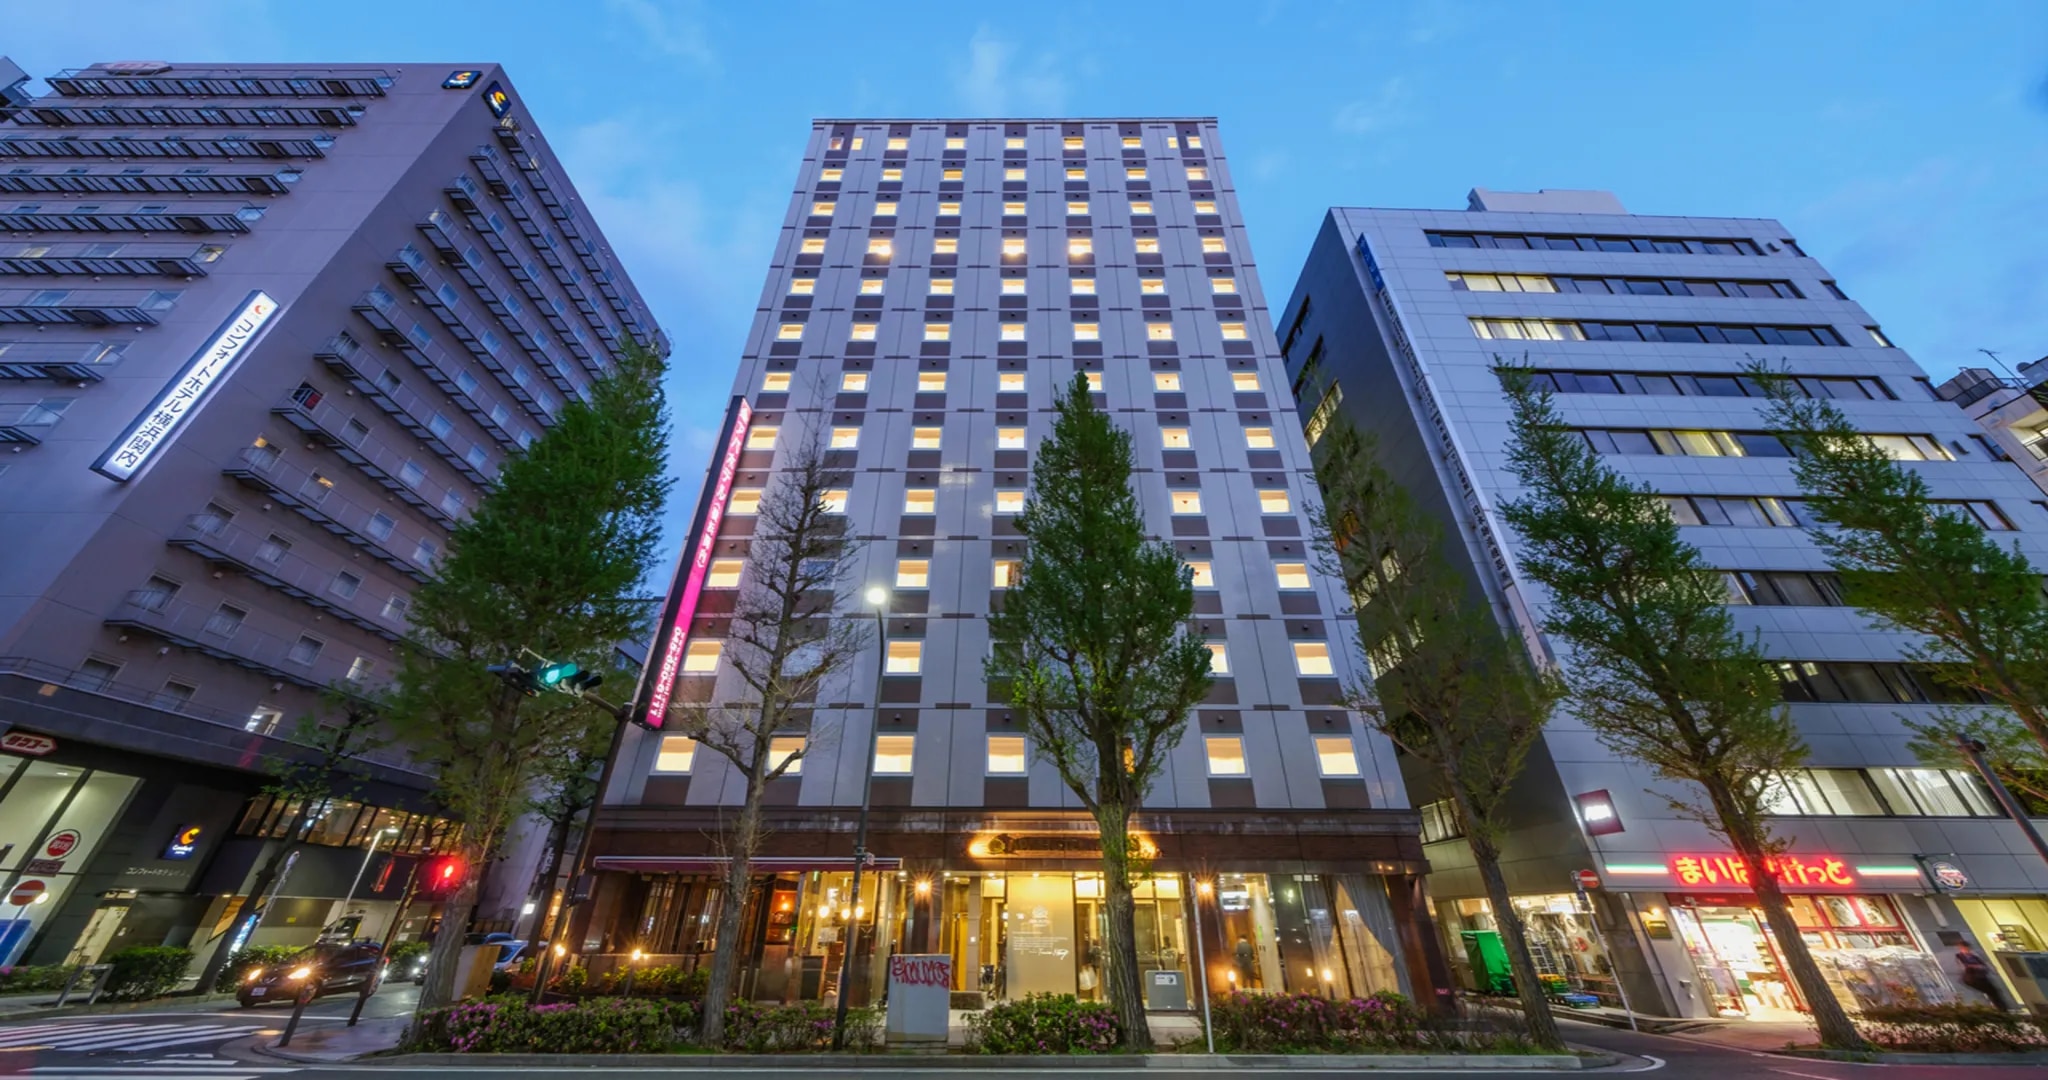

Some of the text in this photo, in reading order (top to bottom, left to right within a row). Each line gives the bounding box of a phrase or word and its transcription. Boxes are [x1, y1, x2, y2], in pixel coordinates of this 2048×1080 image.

[115, 319, 254, 469] コンフォートホテル横浜関内
[1675, 856, 1853, 886] まいばけっと
